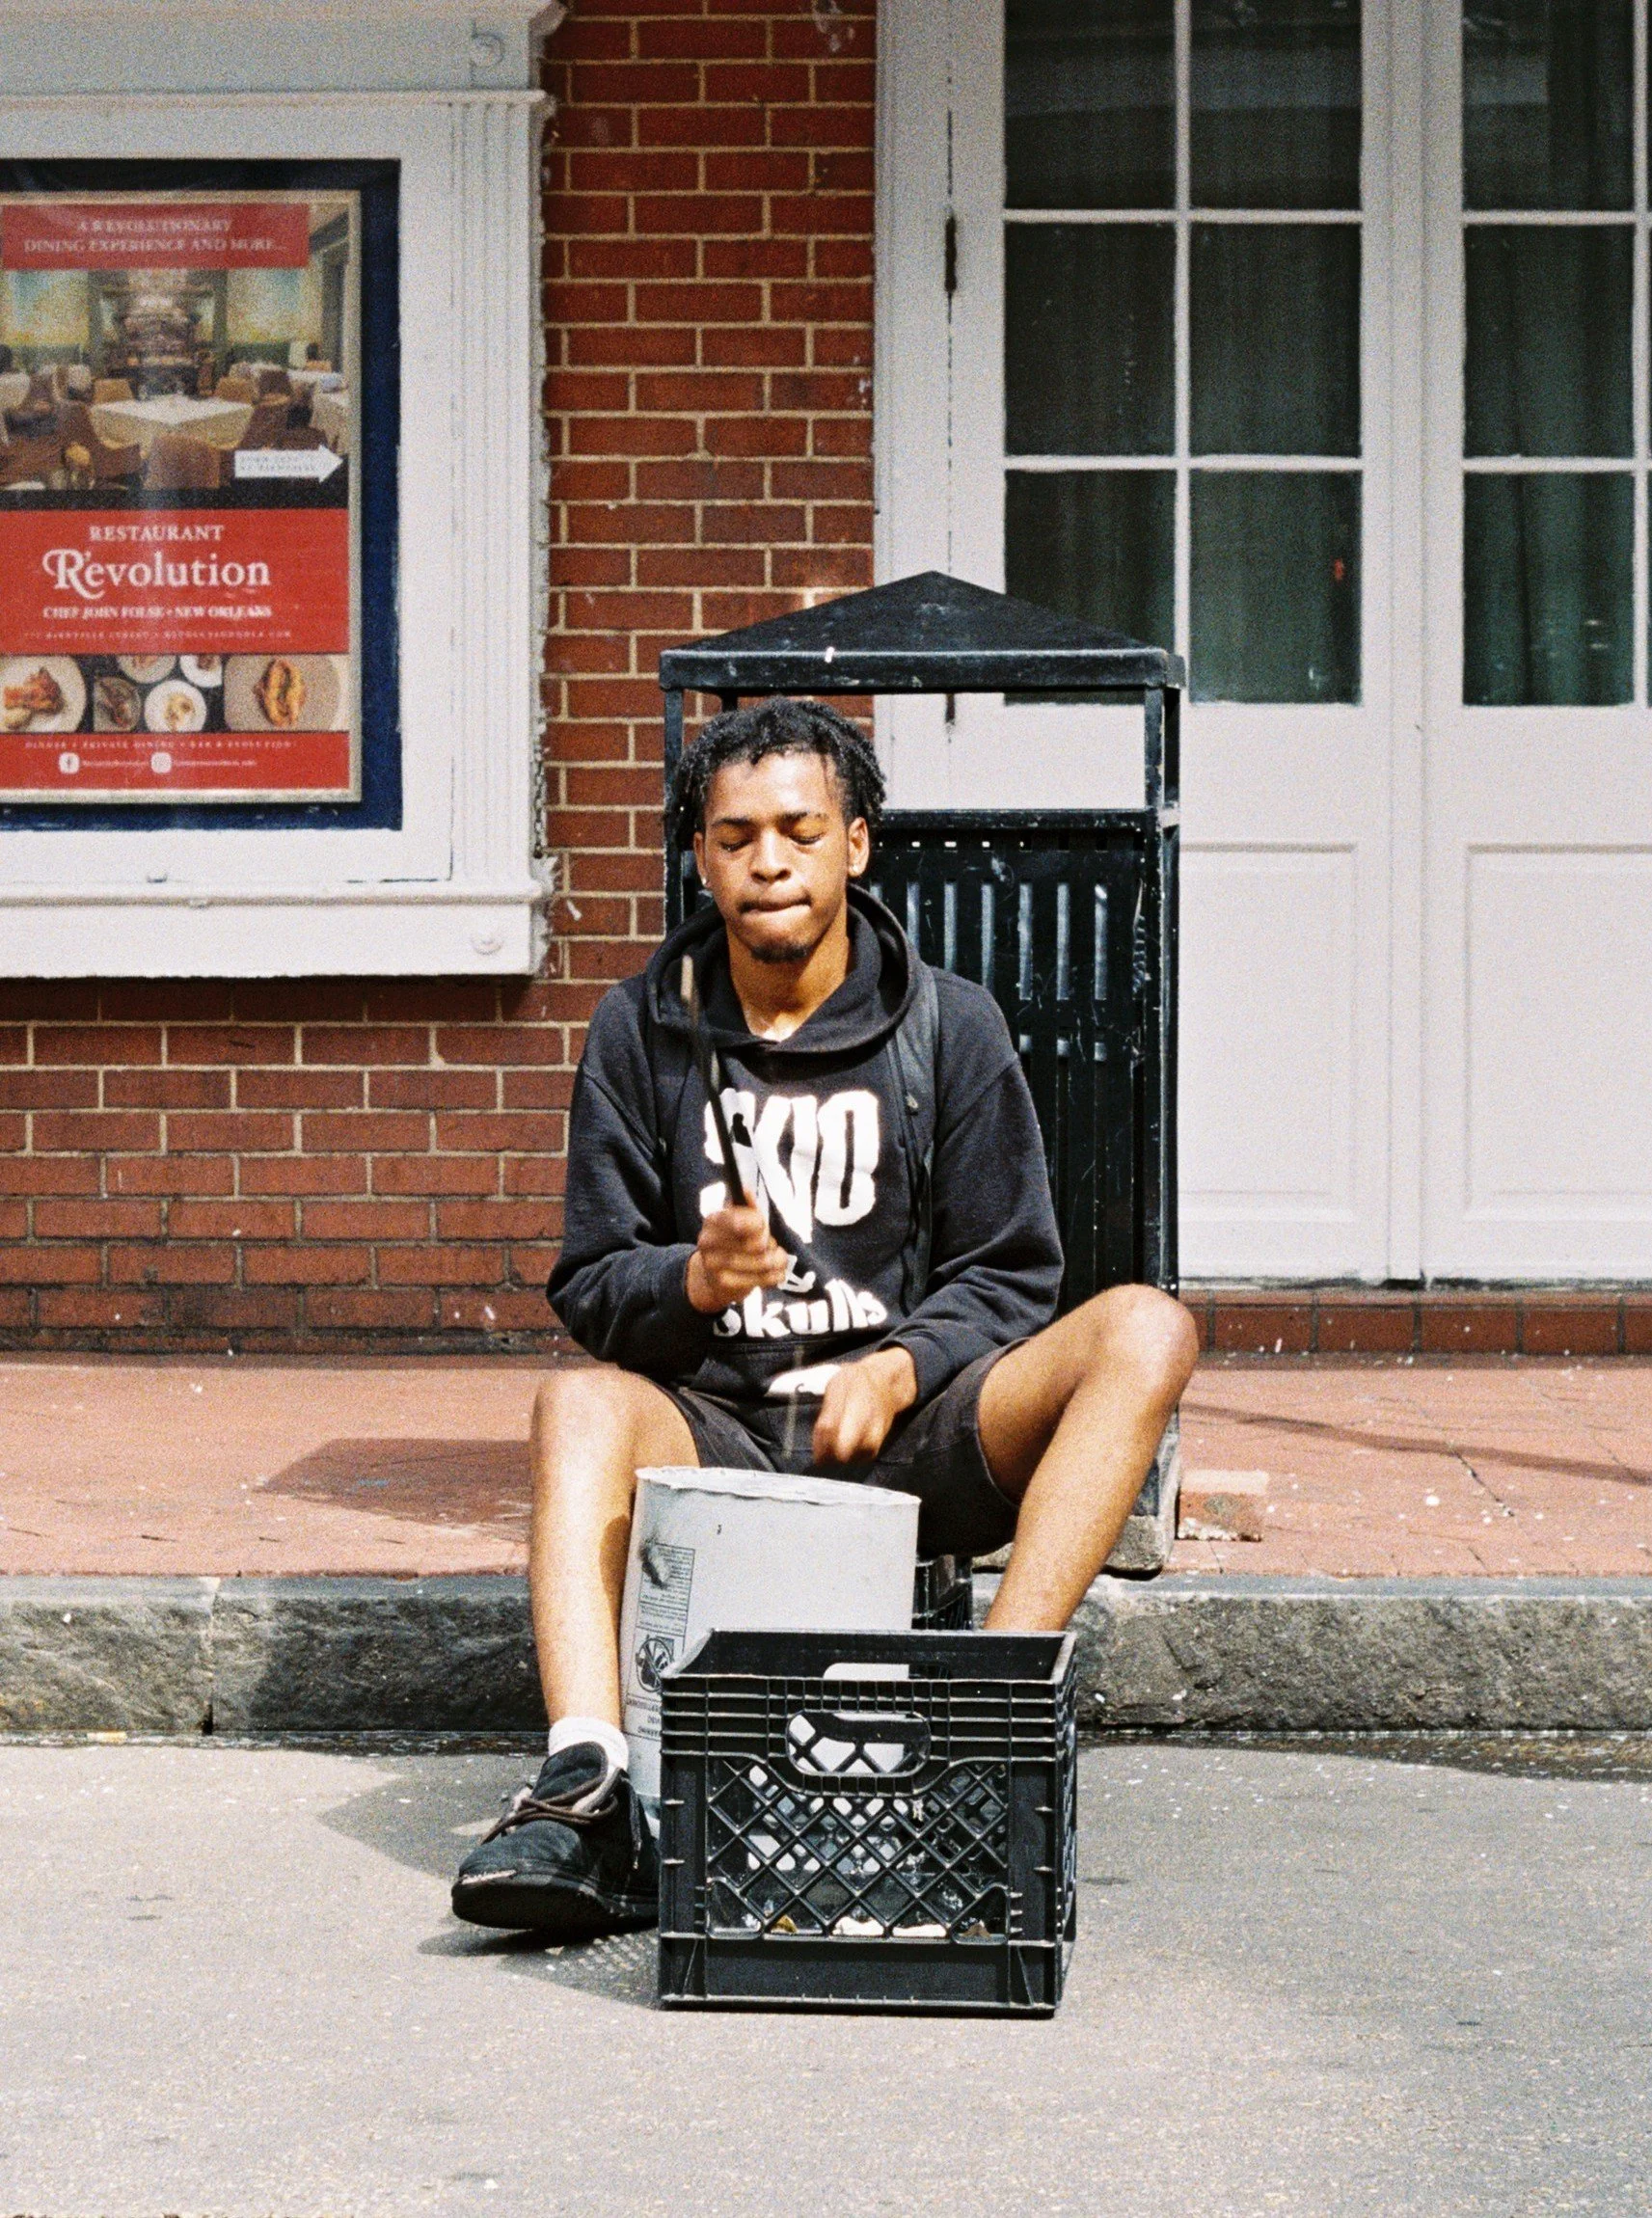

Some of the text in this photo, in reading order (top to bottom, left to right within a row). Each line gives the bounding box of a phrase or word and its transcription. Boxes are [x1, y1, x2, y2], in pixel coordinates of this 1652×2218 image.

[24, 238, 86, 253] DINING
[89, 238, 185, 253] EXPERIENCE
[192, 238, 228, 253] AND
[89, 525, 225, 542] RESTAURANT
[42, 606, 80, 619] CHEF
[82, 606, 119, 620] JOHN
[175, 606, 205, 619] NEW
[207, 606, 273, 621] ORLEANS
